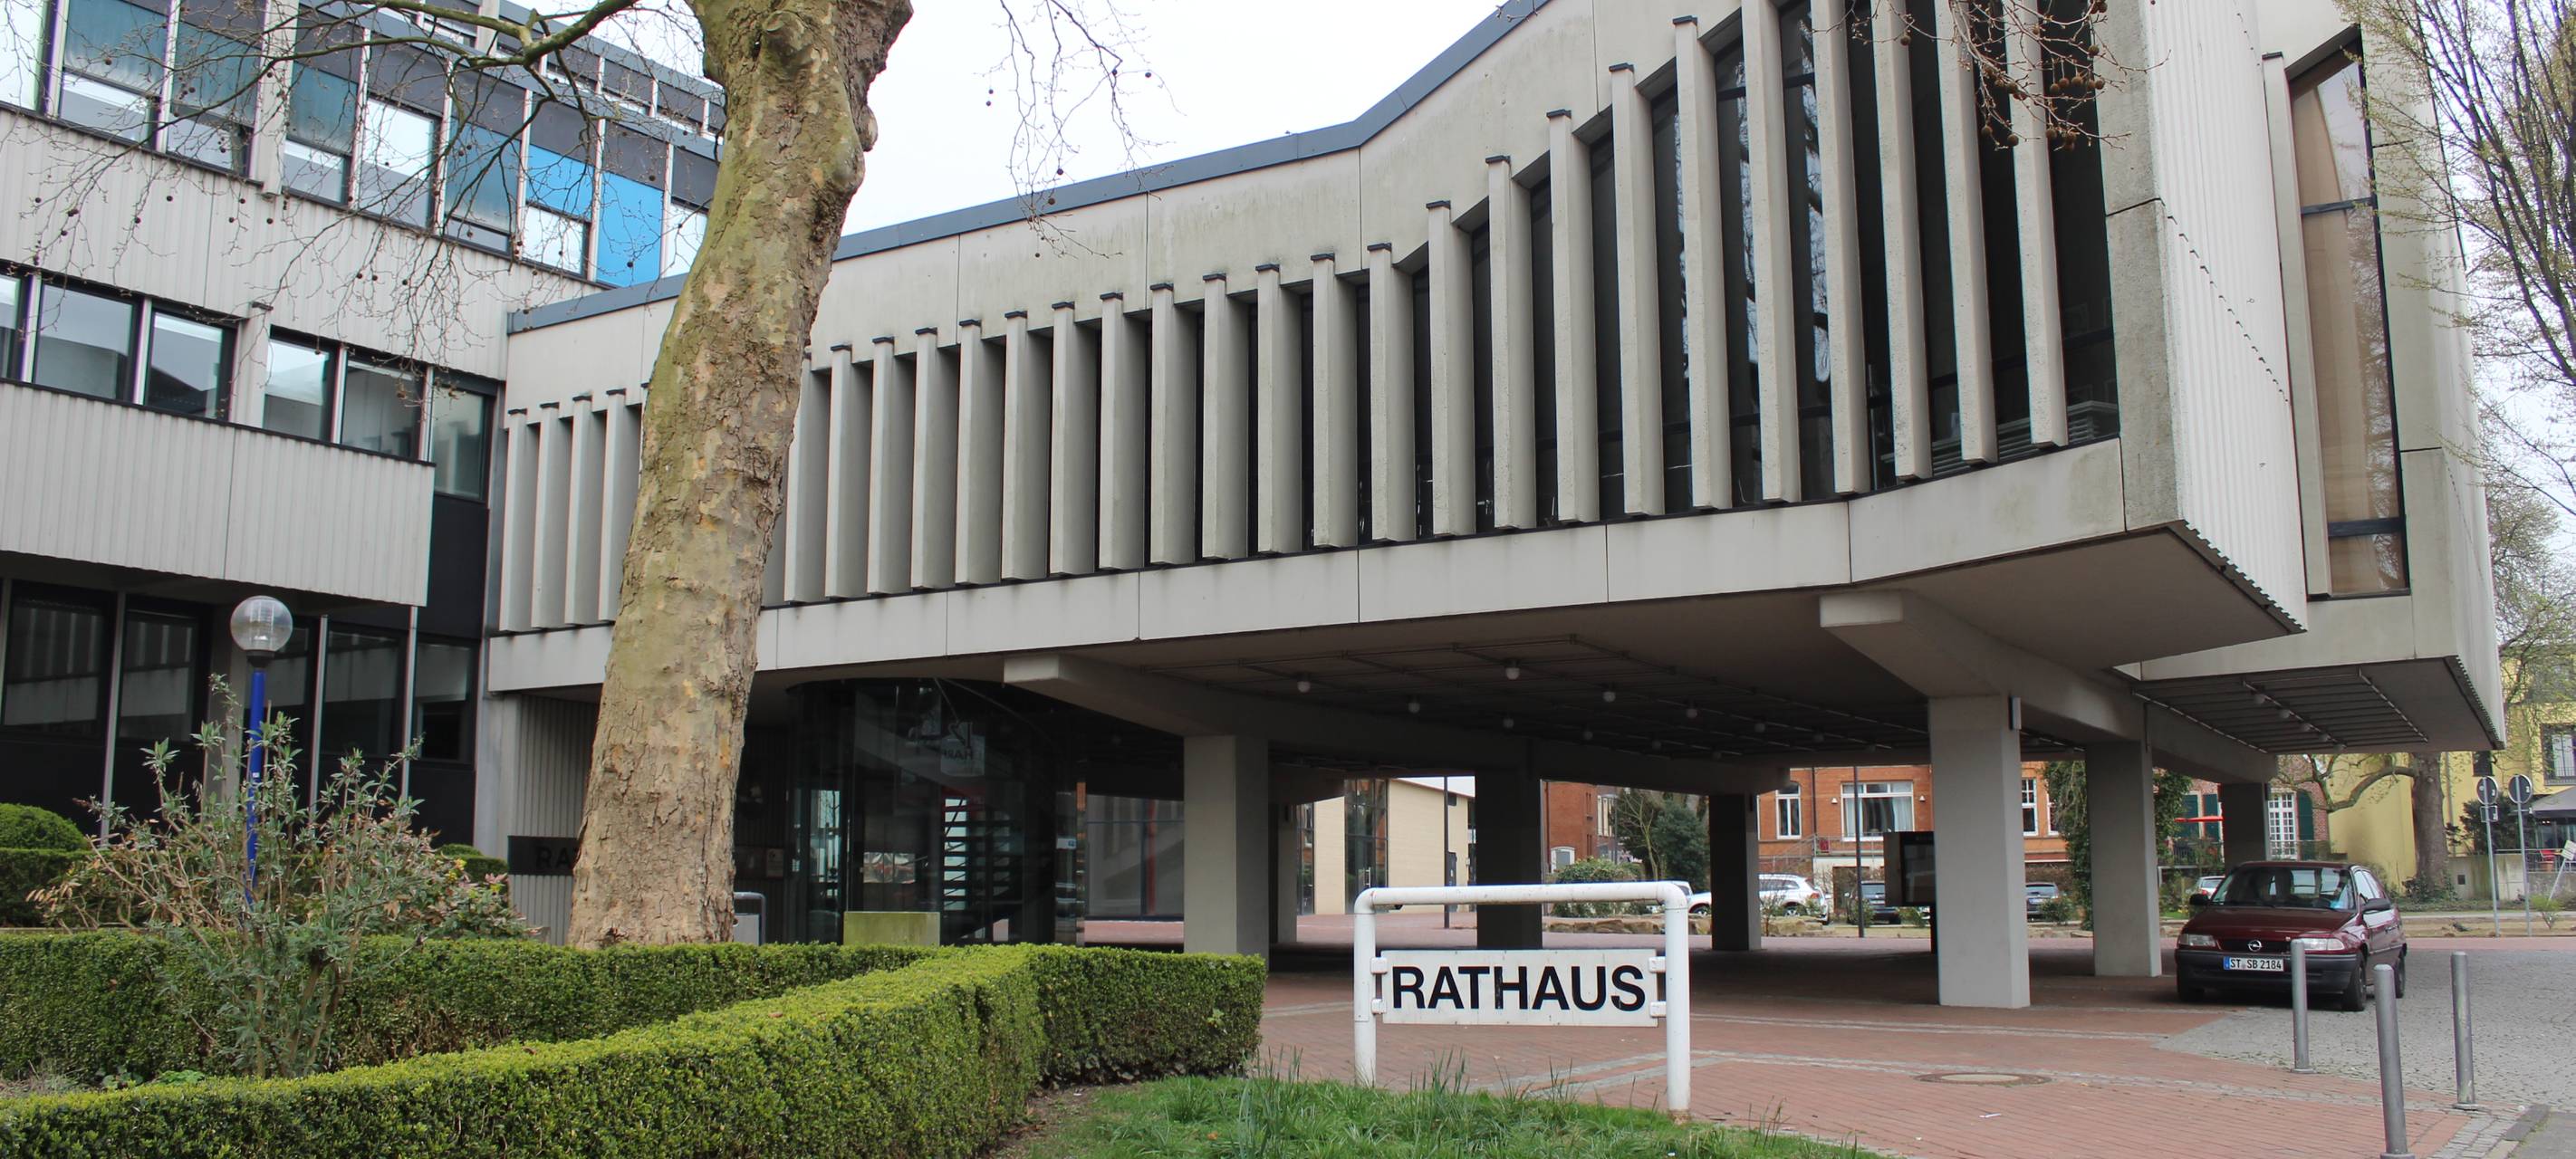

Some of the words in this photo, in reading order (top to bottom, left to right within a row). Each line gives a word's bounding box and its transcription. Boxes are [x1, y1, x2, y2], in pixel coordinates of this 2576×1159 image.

[2230, 958, 2241, 968] ST
[2247, 959, 2258, 969] SB
[2260, 960, 2282, 970] 2184
[1391, 964, 1647, 1012] RATHAUS
